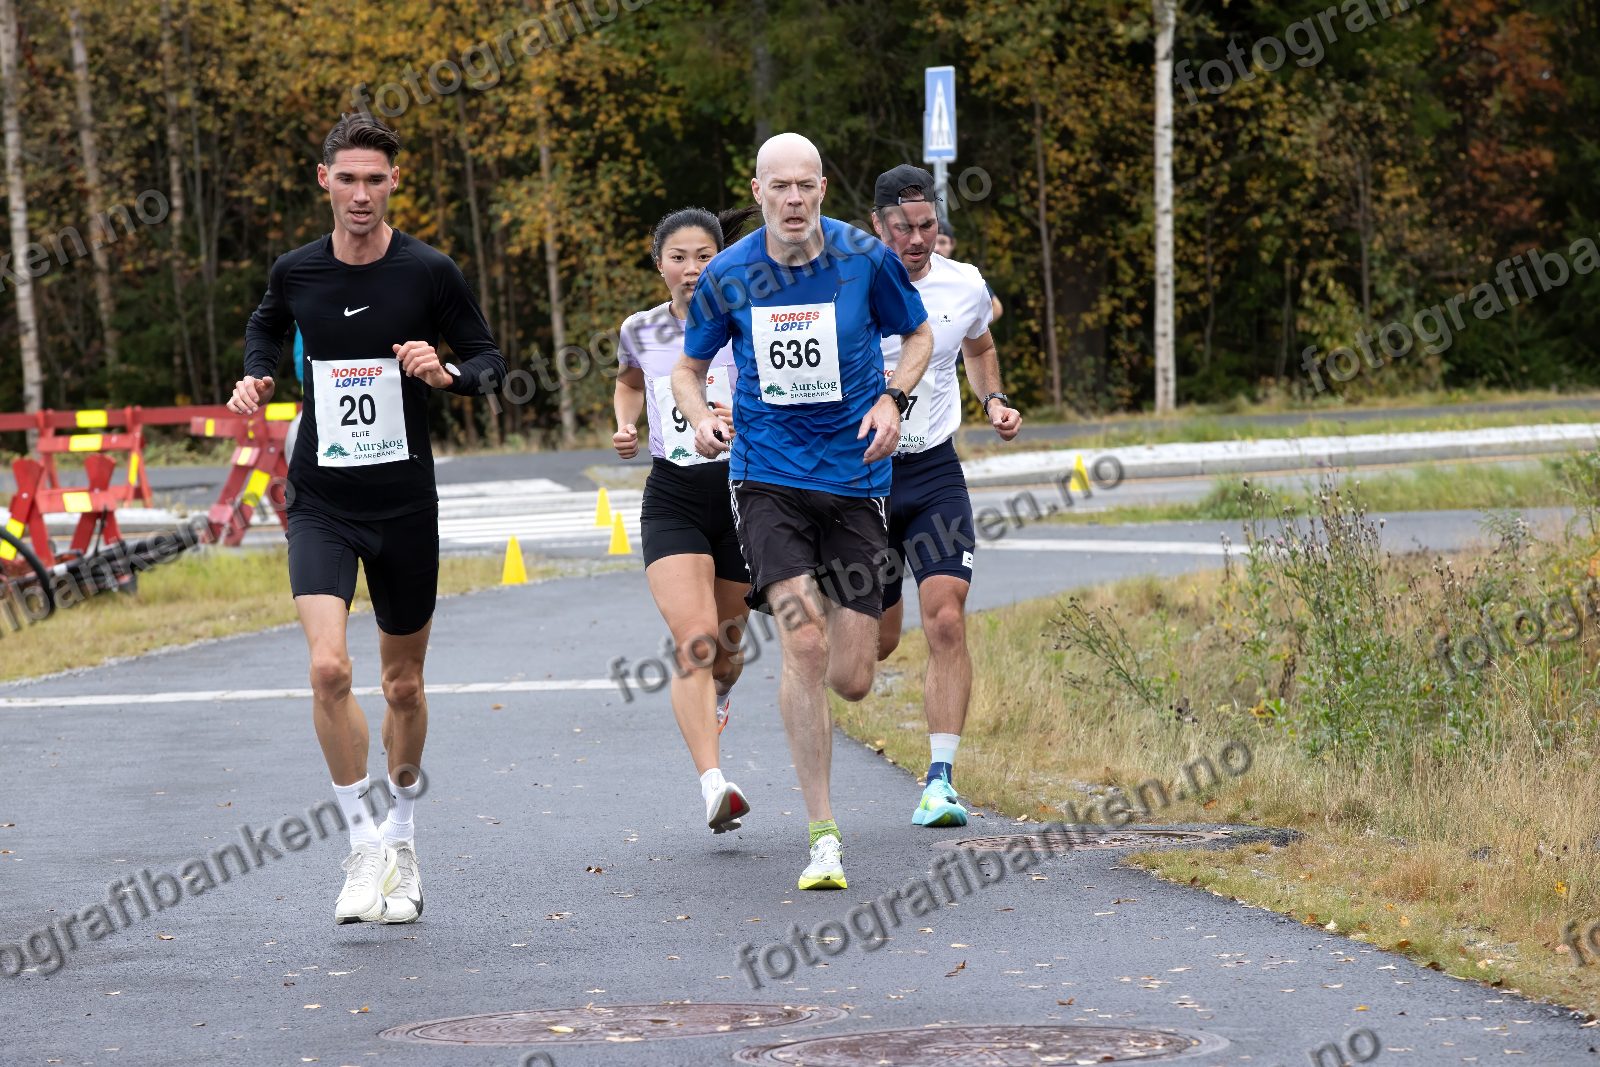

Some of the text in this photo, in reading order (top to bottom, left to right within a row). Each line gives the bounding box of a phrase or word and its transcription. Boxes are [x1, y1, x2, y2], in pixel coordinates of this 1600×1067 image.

[770, 311, 820, 323] NORGES
[774, 321, 813, 332] LØPET
[769, 338, 821, 370] 636
[331, 366, 383, 378] NORGES
[335, 377, 375, 388] LØPET
[790, 380, 837, 391] Aurskog
[339, 394, 376, 426] 20
[354, 439, 404, 452] Aurskog
